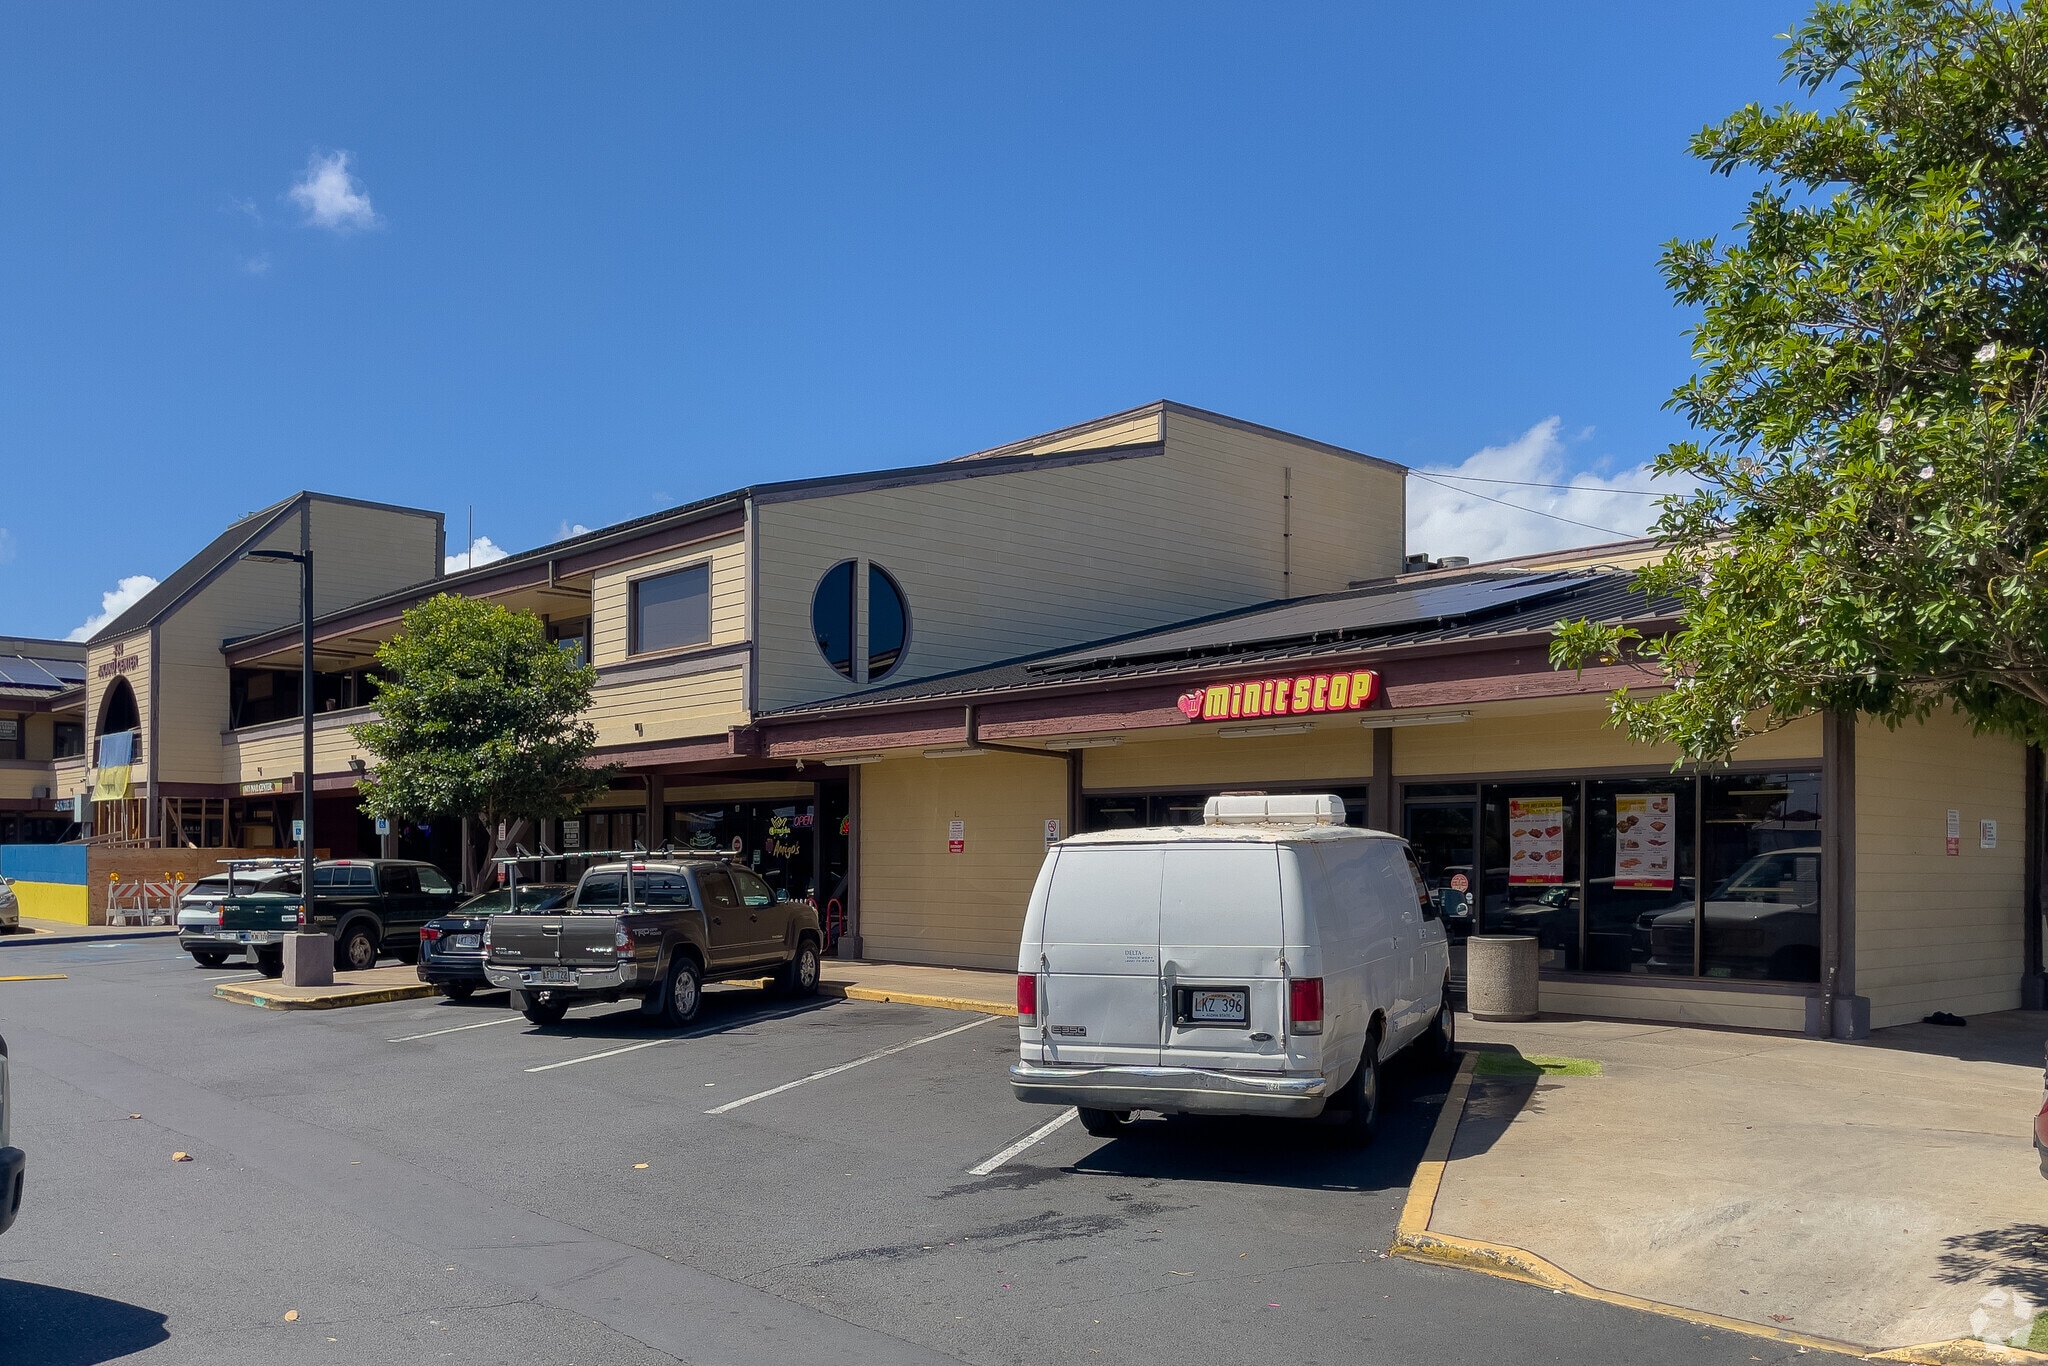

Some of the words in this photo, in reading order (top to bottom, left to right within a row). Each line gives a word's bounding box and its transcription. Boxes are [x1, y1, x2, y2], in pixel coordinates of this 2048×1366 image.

[794, 815, 813, 826] OPEN
[773, 840, 800, 859] Amigo's
[1195, 998, 1215, 1012] LKZ
[1222, 998, 1242, 1013] 396
